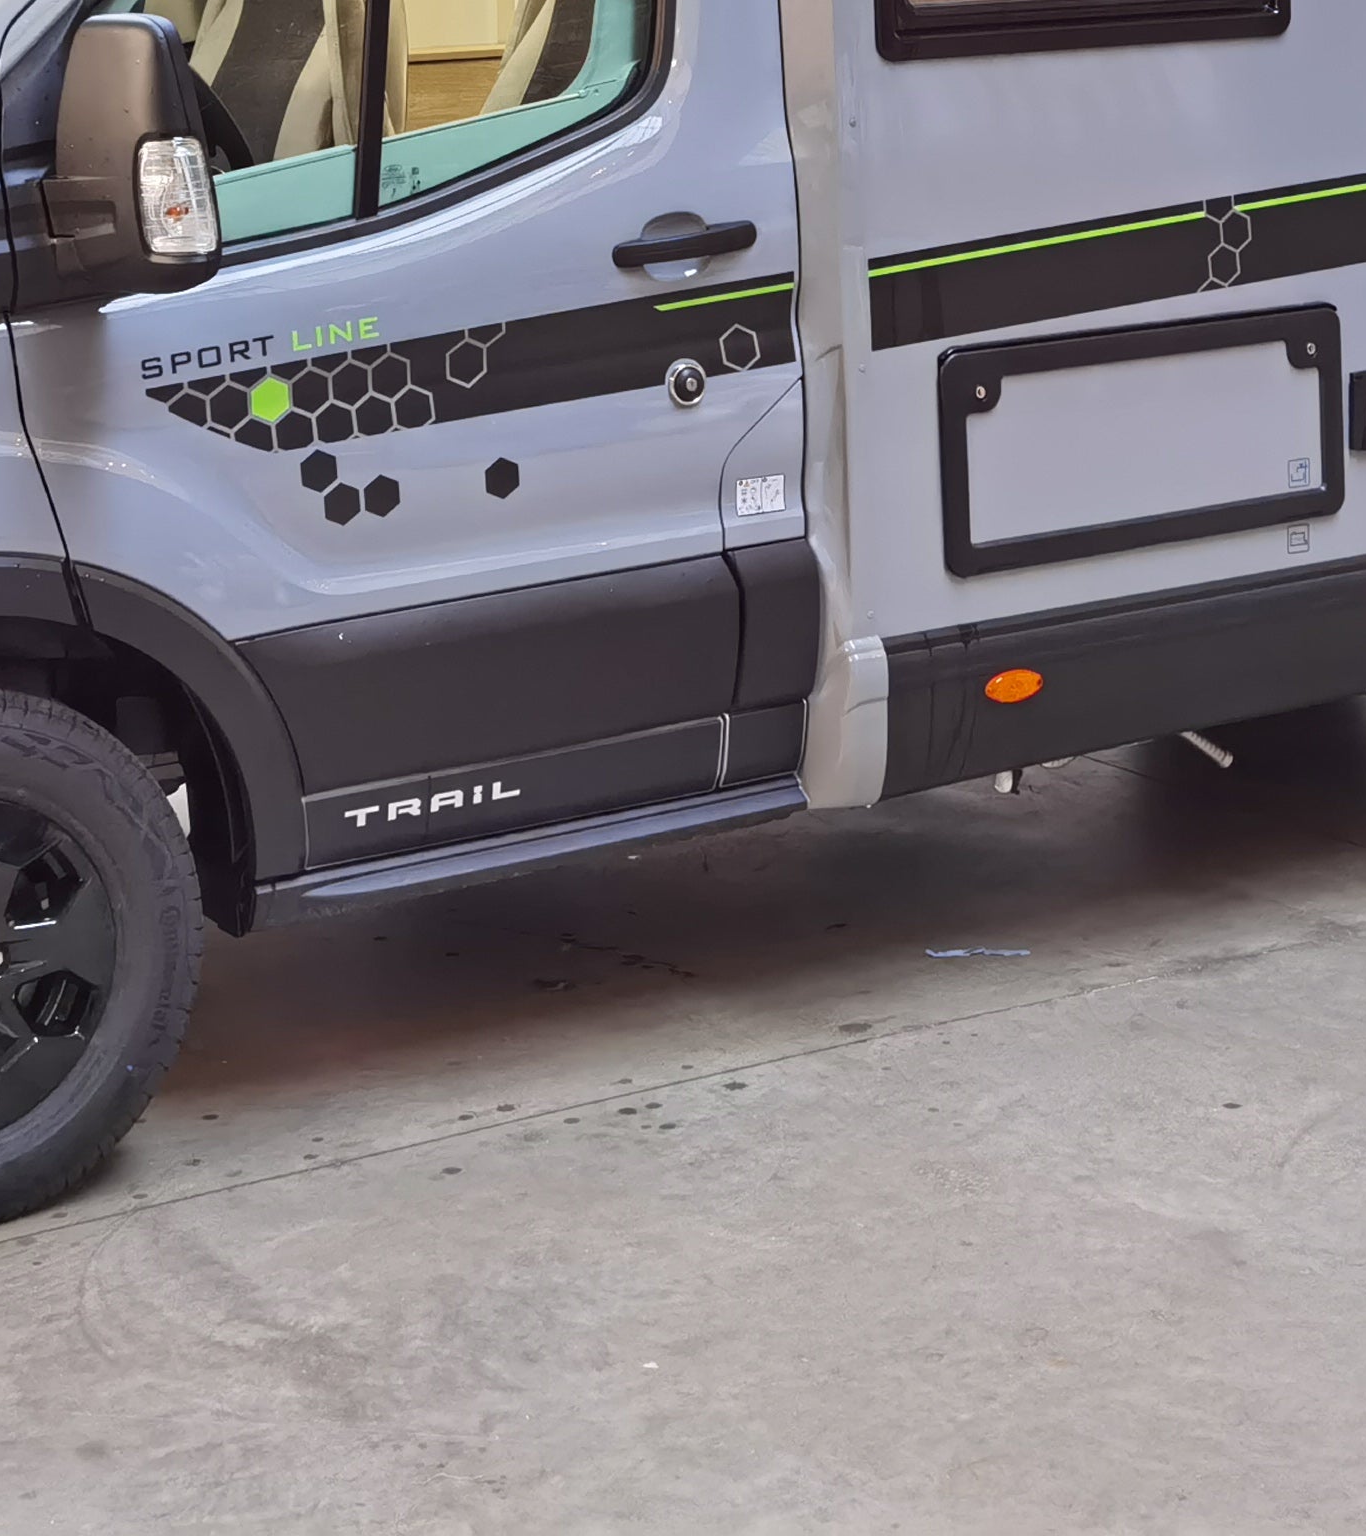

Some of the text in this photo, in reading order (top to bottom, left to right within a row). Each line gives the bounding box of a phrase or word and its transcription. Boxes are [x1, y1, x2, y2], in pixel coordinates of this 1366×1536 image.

[141, 317, 380, 379] SPORT LINE
[344, 781, 521, 827] TRAIL
